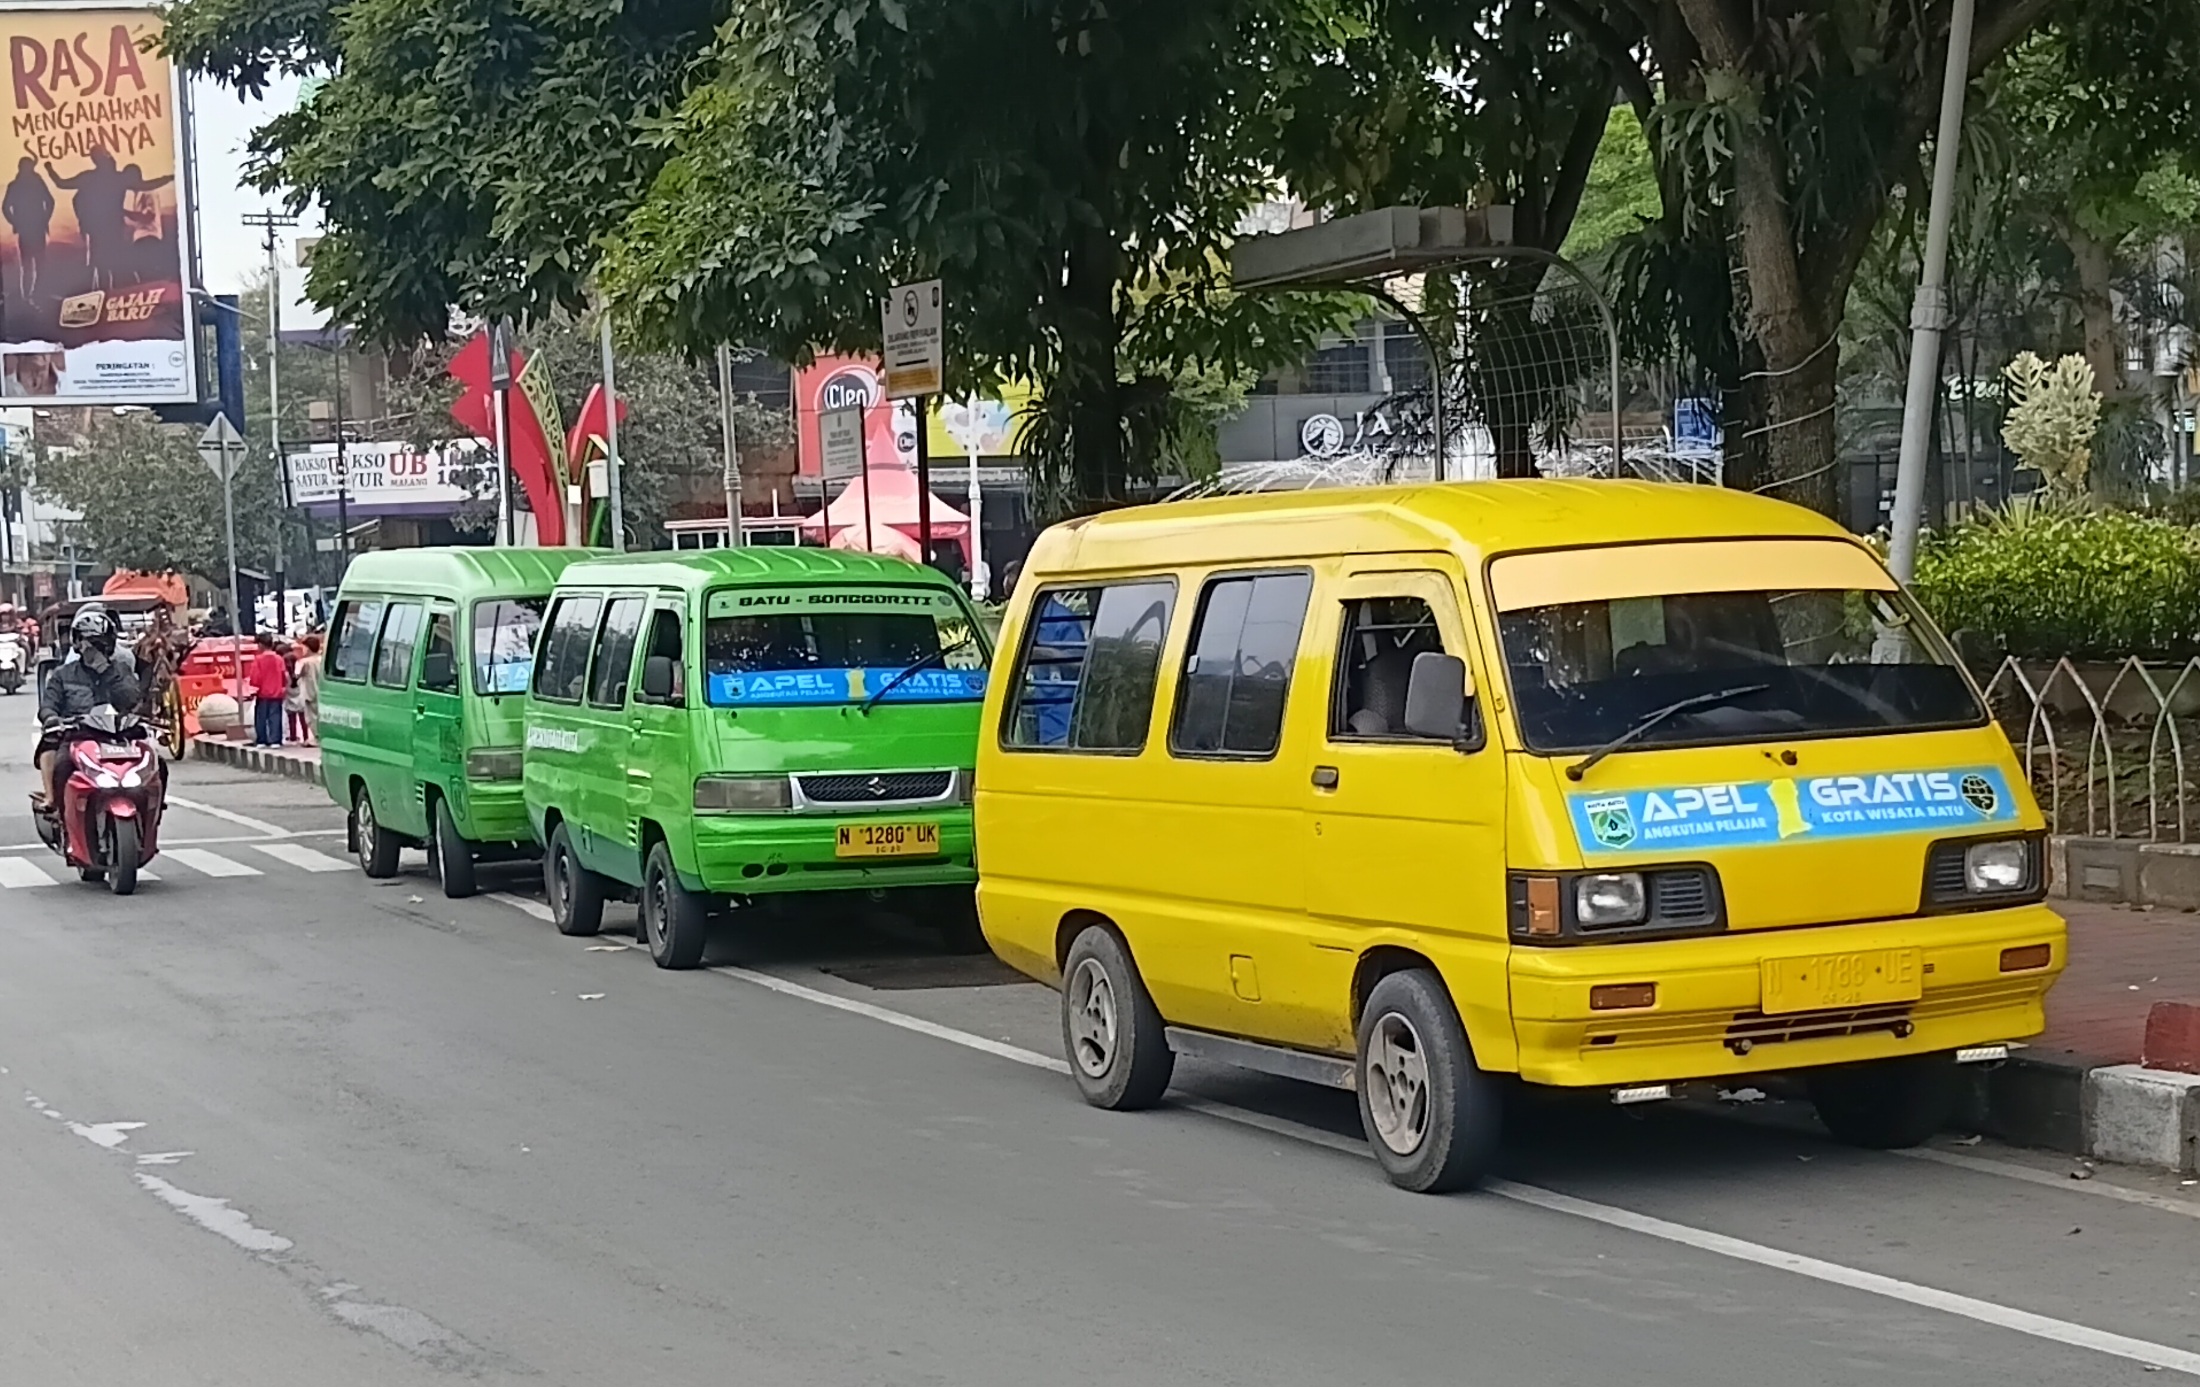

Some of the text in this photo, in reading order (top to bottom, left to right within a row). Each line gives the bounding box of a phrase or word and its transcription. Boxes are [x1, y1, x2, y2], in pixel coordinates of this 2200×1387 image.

[10, 25, 146, 110] RASA
[12, 93, 162, 138] MENGALAHKAN
[23, 122, 155, 165] SEGALANYA
[106, 288, 166, 311] GAJAH
[107, 305, 155, 322] BARU
[829, 384, 867, 409] Cleo
[352, 454, 385, 469] KSO
[390, 453, 428, 475] UB
[295, 473, 328, 488] SAYUR
[739, 596, 790, 606] BATU
[749, 673, 962, 692] APEL GRATIS
[1642, 773, 1958, 823] APEL GRATIS
[1821, 806, 1964, 823] KOTA WISATA BATU
[840, 825, 936, 845] N 1280 UK
[1644, 817, 1767, 840] ANGKUTAN PELAJAR
[1767, 960, 1782, 996] N
[1884, 950, 1912, 984] UE
